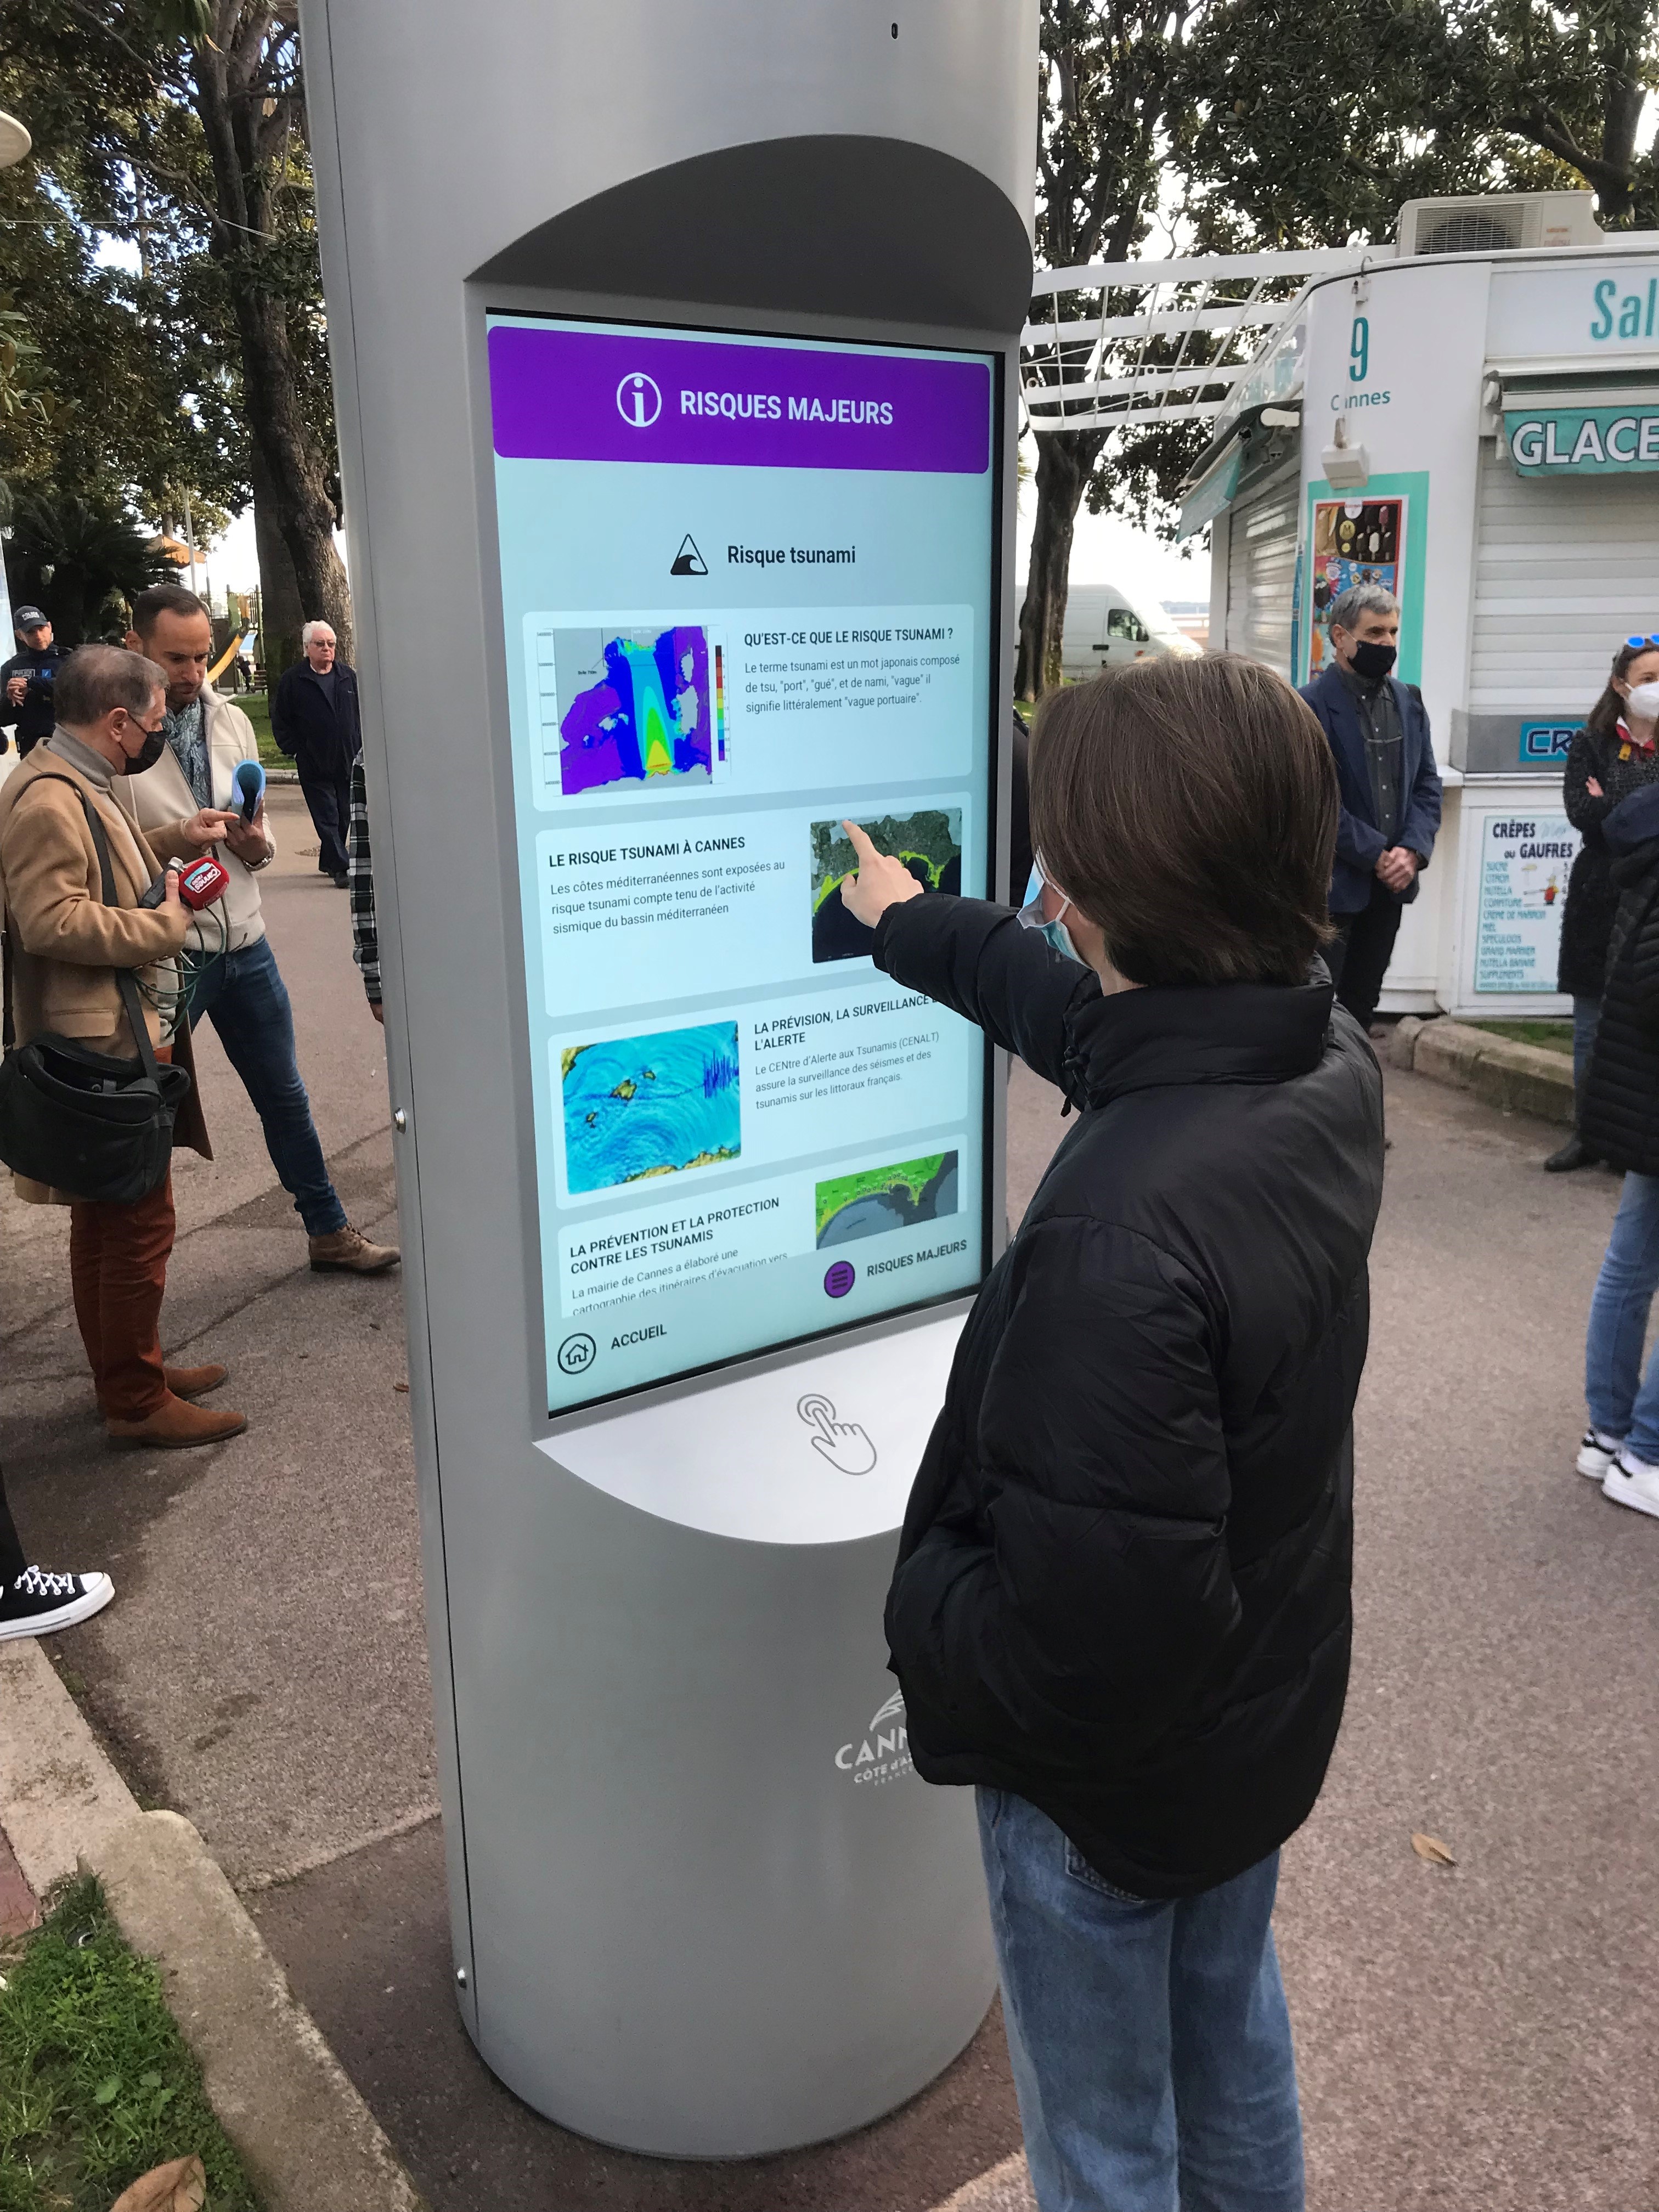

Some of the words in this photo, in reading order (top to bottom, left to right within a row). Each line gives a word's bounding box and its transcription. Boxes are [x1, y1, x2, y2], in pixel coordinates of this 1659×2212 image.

[1350, 317, 1369, 382] 9
[680, 390, 781, 420] RISQUES
[788, 397, 893, 425] MAJEURS
[1511, 417, 1659, 466] GLACE
[727, 545, 786, 567] Risque
[790, 545, 855, 563] tsunami
[744, 632, 806, 647] QU'EST-CE
[810, 631, 833, 644] QUE
[836, 630, 849, 643] LE
[852, 629, 892, 643] RISQUE
[895, 628, 945, 641] TSUNAMI
[947, 627, 953, 639] ?
[745, 663, 757, 674] Le
[759, 663, 788, 673] terme
[791, 659, 828, 672] tsunami
[831, 660, 845, 670] est
[847, 661, 859, 669] un
[861, 658, 878, 668] mot
[881, 657, 918, 670] japonais
[920, 654, 960, 668] composé
[746, 682, 758, 693] de
[760, 682, 778, 693] tsu,
[839, 679, 848, 688] et
[850, 677, 862, 687] de
[865, 675, 889, 688] nami,
[891, 674, 924, 688] "vague"
[926, 674, 931, 684] il
[746, 701, 781, 715] signifie
[783, 697, 842, 710] littéralement
[844, 696, 875, 709] "vague
[1527, 728, 1577, 755] CR
[549, 854, 565, 867] LE
[569, 849, 617, 865] RISQUE
[620, 843, 680, 860] TSUNAMI
[683, 839, 692, 854] À
[695, 837, 746, 853] CANNES
[1520, 843, 1573, 859] GAUFRES
[551, 884, 570, 895] Les
[573, 880, 603, 893] côtes
[606, 871, 699, 889] méditerranéennes
[702, 867, 723, 878] sont
[726, 862, 771, 877] exposées
[774, 861, 785, 870] au
[551, 901, 585, 915] risque
[588, 895, 630, 910] tsunami
[634, 892, 673, 907] compte
[675, 889, 697, 900] tenu
[700, 887, 712, 897] de
[553, 919, 602, 934] sismique
[605, 917, 618, 928] du
[621, 912, 654, 926] bassin
[657, 903, 729, 922] méditerranéen
[754, 1023, 769, 1035] LA
[772, 1012, 834, 1031] PRÉVISION,
[836, 1008, 850, 1020] LA
[853, 995, 929, 1017] SURVEILLANCE
[754, 1032, 806, 1051] L'ALERTE
[755, 1065, 766, 1075] Le
[769, 1059, 800, 1073] CENtre
[839, 1049, 854, 1059] aux
[856, 1040, 897, 1056] Tsunamis
[899, 1031, 939, 1049] (CENALT)
[755, 1080, 786, 1092] assure
[788, 1076, 796, 1086] la
[798, 1066, 850, 1084] surveillance
[852, 1063, 868, 1073] des
[870, 1055, 904, 1070] séismes
[906, 1053, 915, 1062] et
[916, 1051, 932, 1060] des
[756, 1094, 797, 1109] tsunamis
[799, 1091, 812, 1101] sur
[815, 1087, 828, 1097] les
[830, 1079, 865, 1094] littoraux
[867, 1072, 902, 1087] français.
[570, 1245, 586, 1257] LA
[590, 1224, 668, 1253] PRÉVENTION
[672, 1220, 686, 1233] ET
[690, 1216, 704, 1228] LA
[708, 1197, 779, 1224] PROTECTION
[571, 1253, 622, 1274] CONTRE
[625, 1246, 648, 1260] LES
[651, 1229, 714, 1254] TSUNAMIS
[769, 1252, 788, 1263] vers
[867, 1255, 913, 1277] RISQUES
[916, 1239, 967, 1263] MAJEURS
[572, 1288, 585, 1299] La
[588, 1280, 619, 1295] mairie
[622, 1275, 634, 1286] de
[637, 1265, 673, 1282] Cannes
[676, 1264, 681, 1272] a
[684, 1253, 719, 1269] élaboré
[721, 1249, 738, 1261] une
[611, 1324, 668, 1350] ACCUEIL
